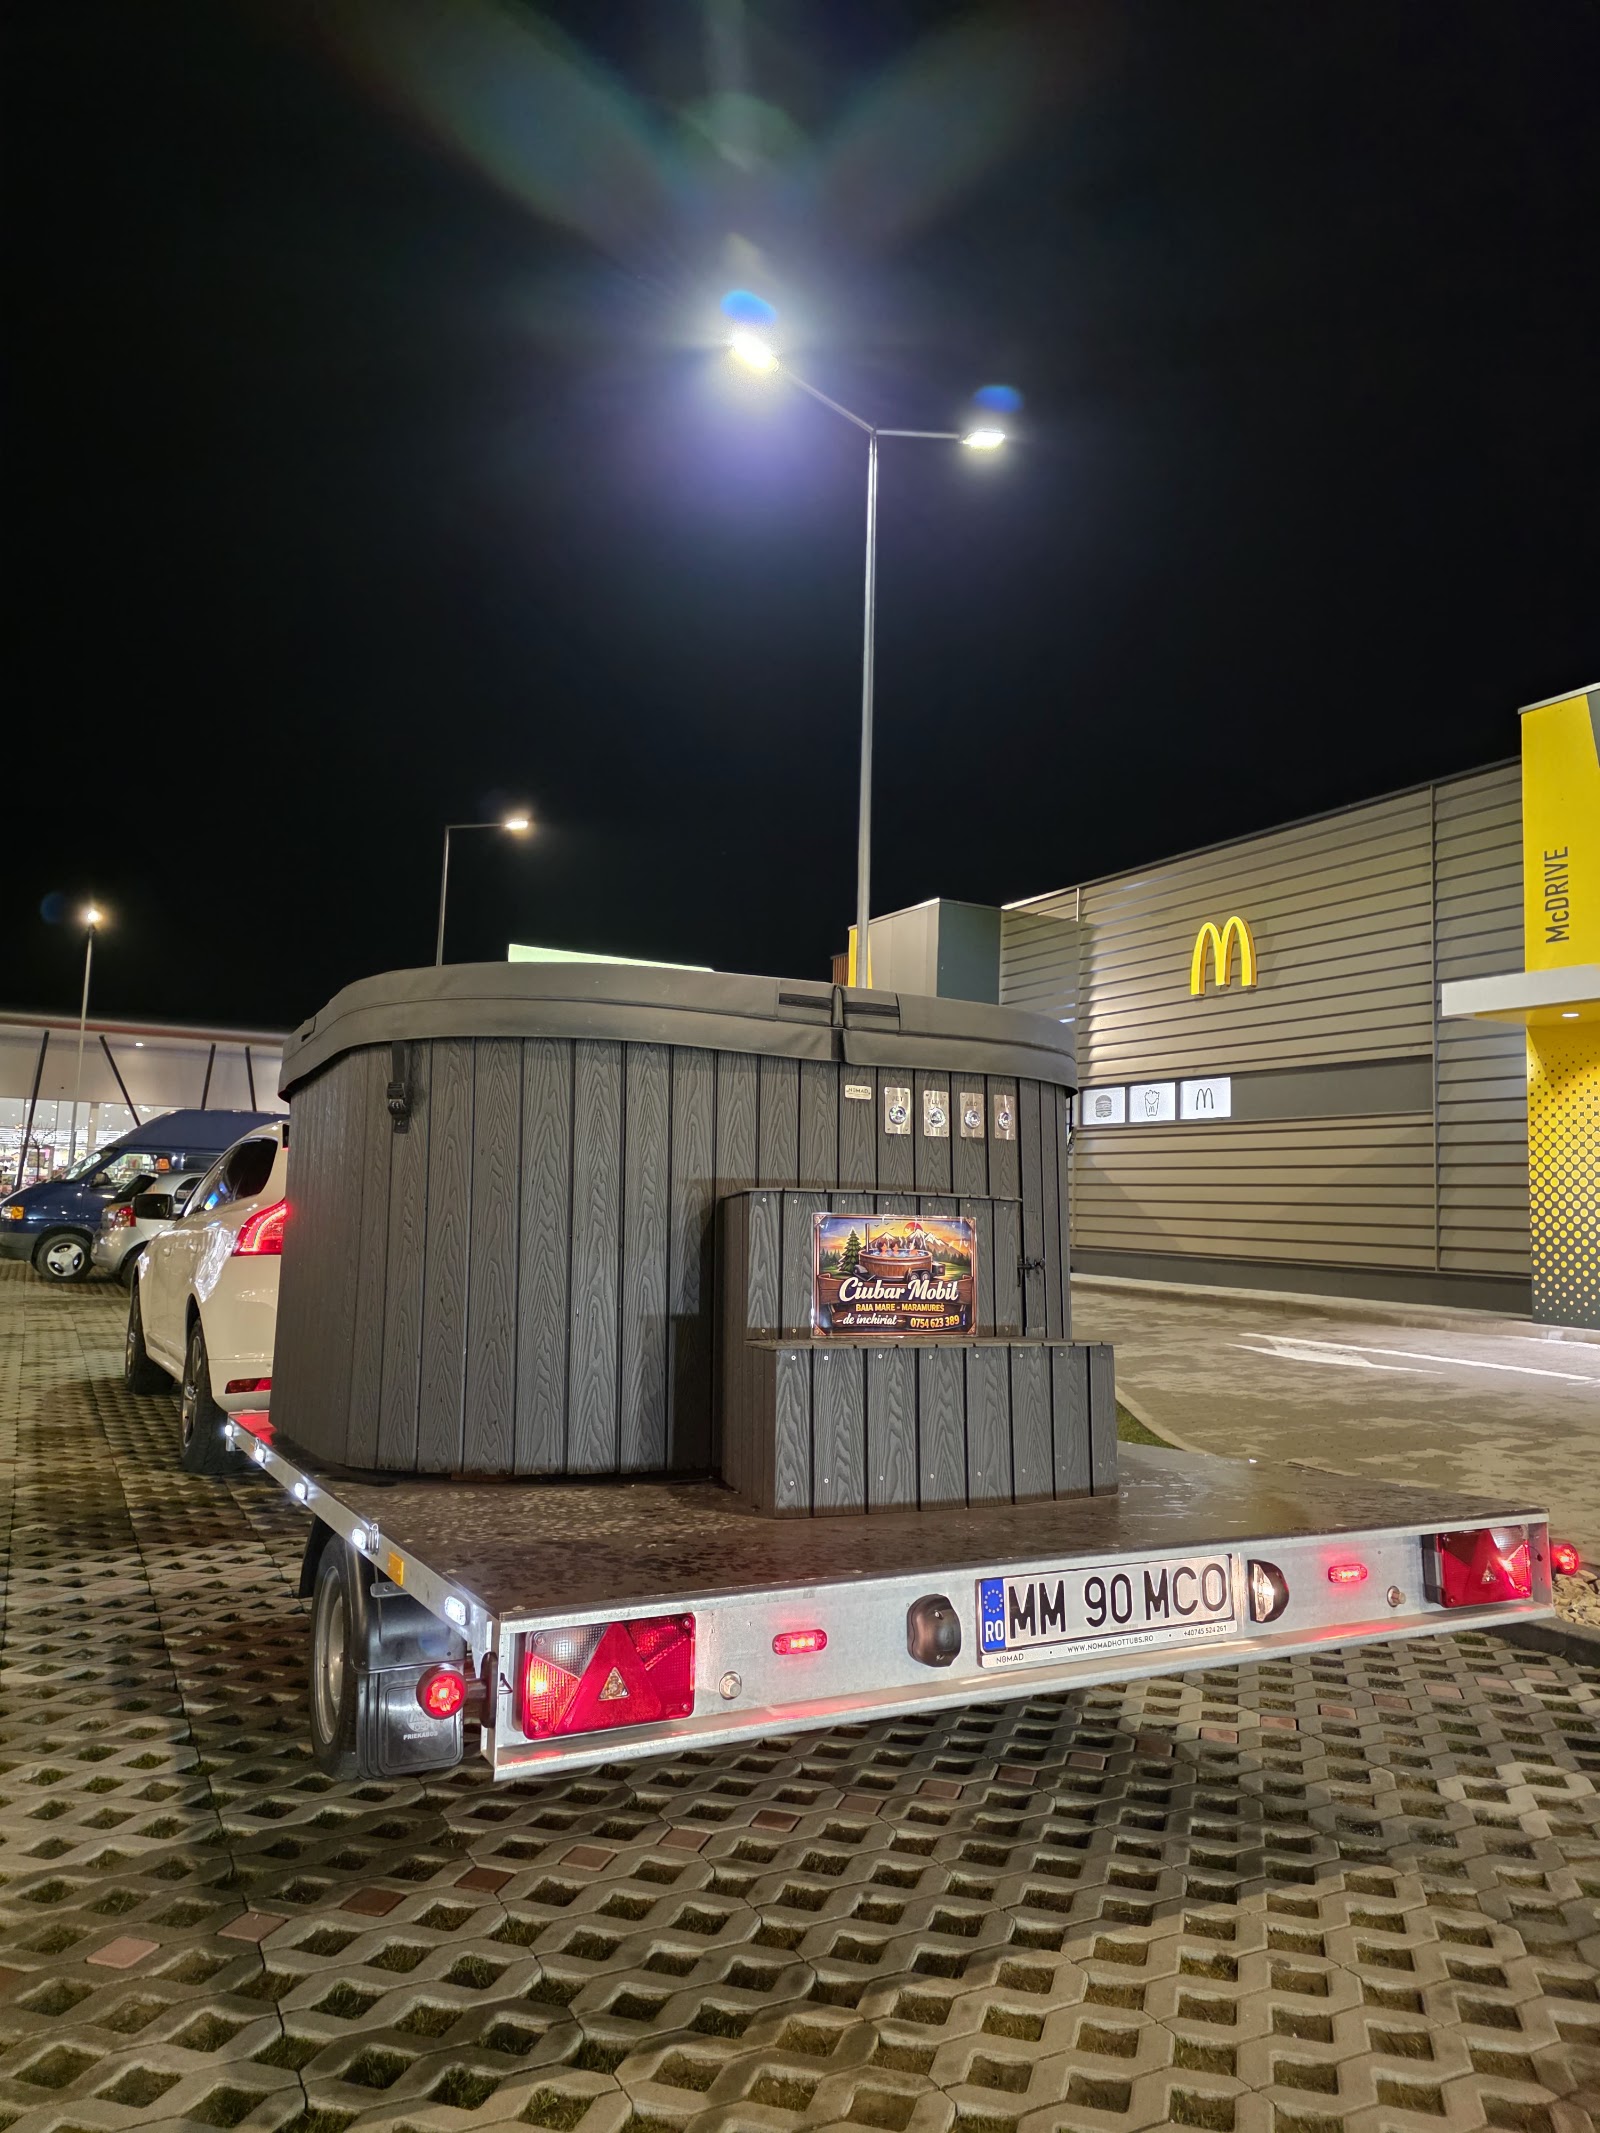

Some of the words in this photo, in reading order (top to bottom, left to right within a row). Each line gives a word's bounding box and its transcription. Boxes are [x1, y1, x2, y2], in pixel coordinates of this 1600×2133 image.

[1544, 846, 1570, 944] McDRIVE
[839, 1277, 905, 1302] Ciubar
[907, 1279, 959, 1302] Mobil
[855, 1303, 874, 1312] BAIA
[875, 1303, 896, 1312] MARE
[842, 1313, 854, 1325] de
[910, 1317, 929, 1329] 0754
[930, 1316, 944, 1328] 623
[945, 1315, 960, 1326] 389
[1008, 1580, 1067, 1640] MM
[1084, 1573, 1133, 1628] 90
[1143, 1563, 1227, 1621] MCO
[985, 1620, 1004, 1643] RO
[1067, 1635, 1154, 1653] WWW.NOMADHOTTUBS.RO
